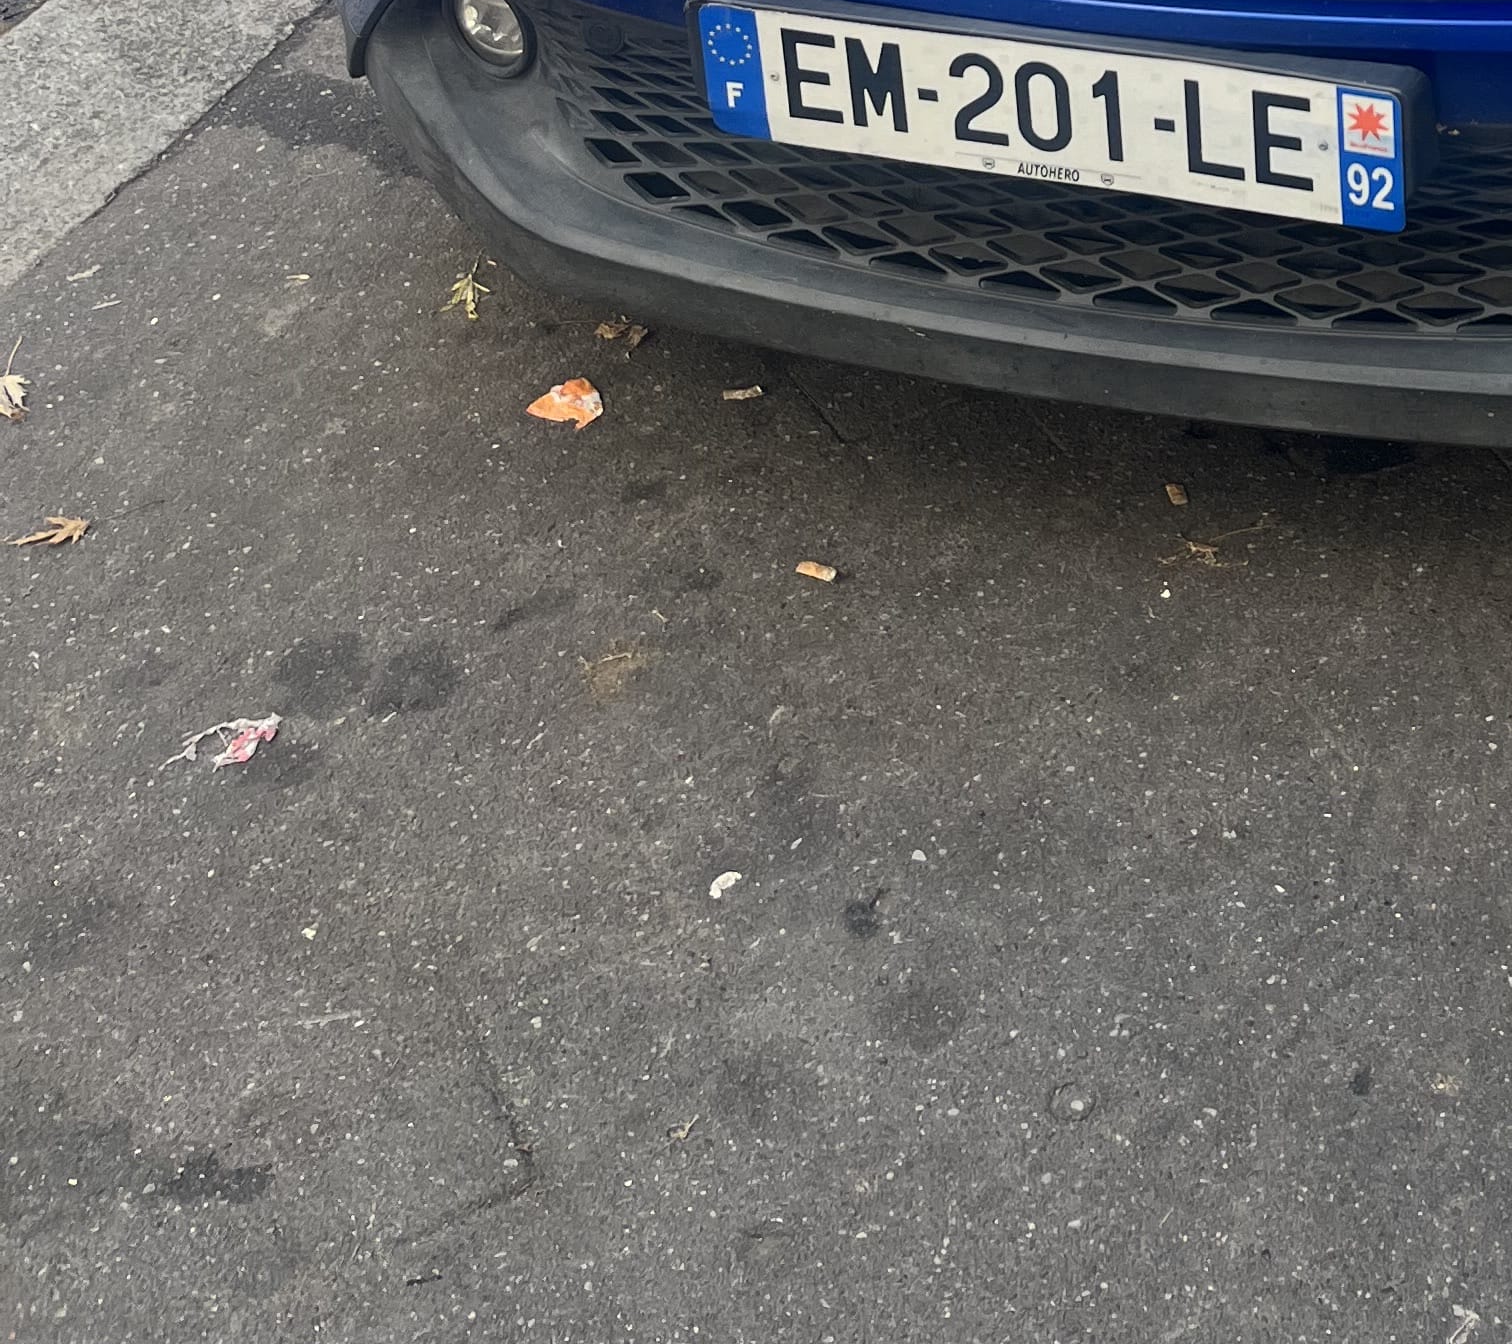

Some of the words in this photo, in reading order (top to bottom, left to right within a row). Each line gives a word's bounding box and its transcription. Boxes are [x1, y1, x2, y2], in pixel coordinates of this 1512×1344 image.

[726, 81, 744, 109] F
[780, 27, 1314, 192] EM-201-LE
[1017, 162, 1080, 182] AUTOHERO
[1347, 162, 1395, 211] 92
